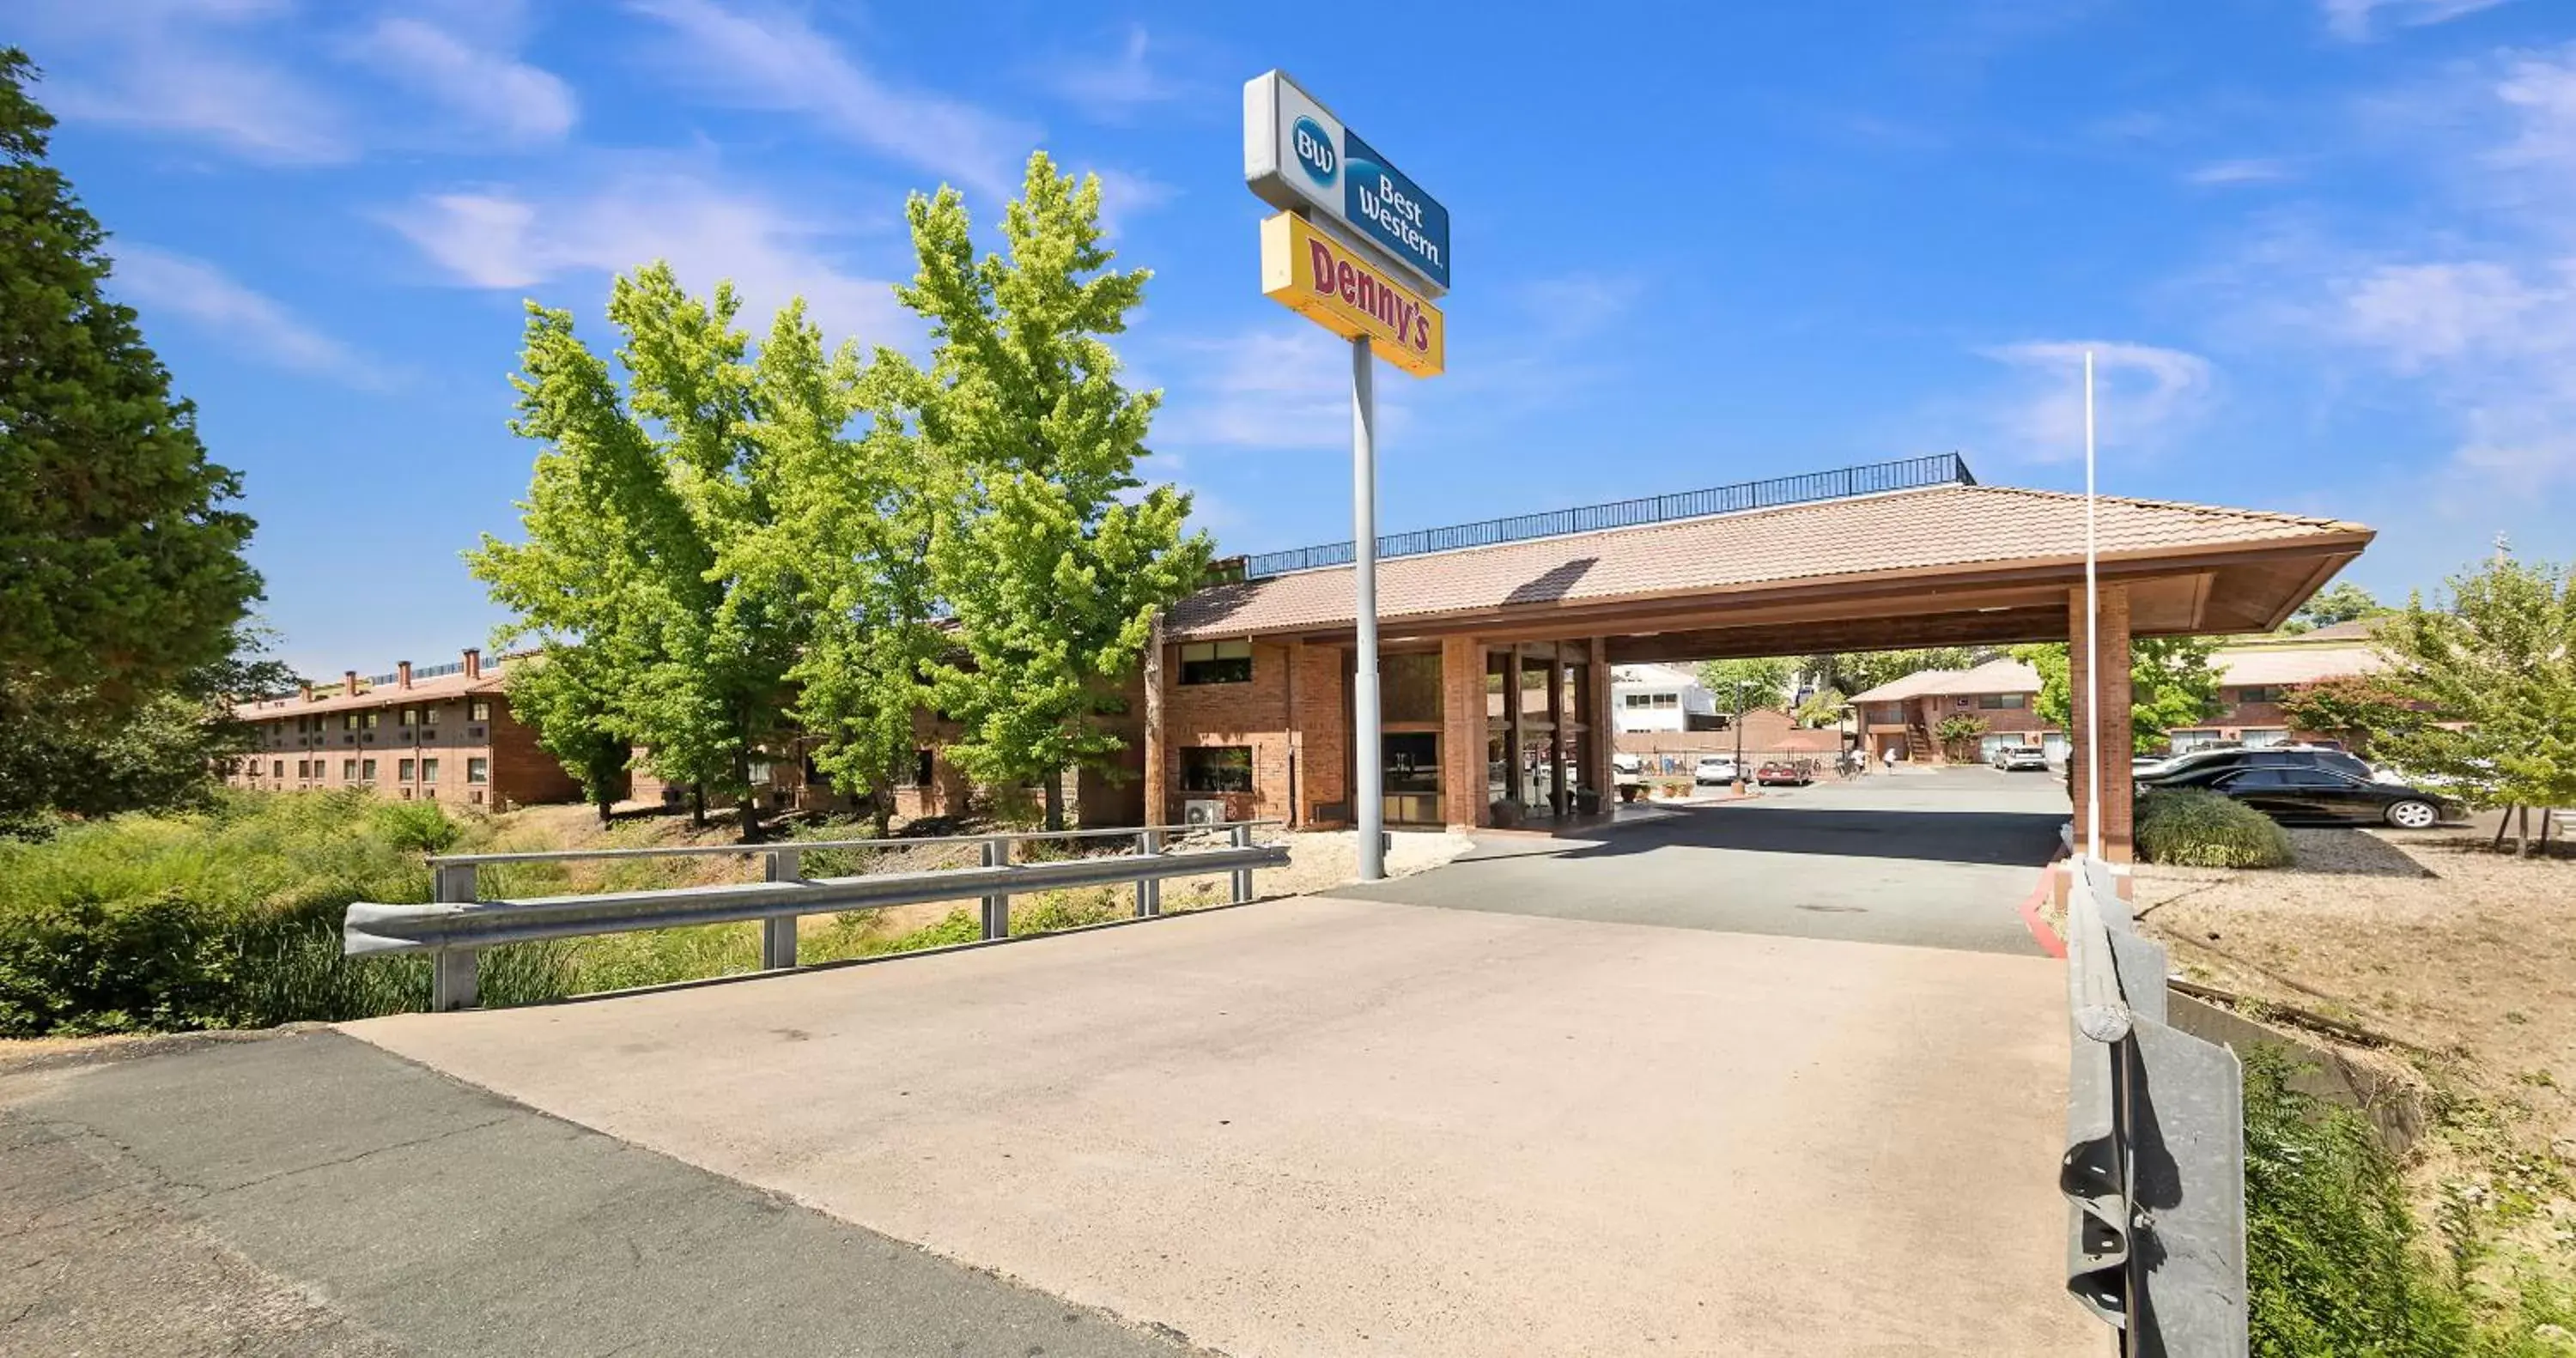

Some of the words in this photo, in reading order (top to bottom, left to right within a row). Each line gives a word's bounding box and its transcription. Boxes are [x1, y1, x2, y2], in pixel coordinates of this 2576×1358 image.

[1297, 129, 1334, 173] BW
[1380, 174, 1423, 229] Best
[1308, 236, 1430, 354] Denny's
